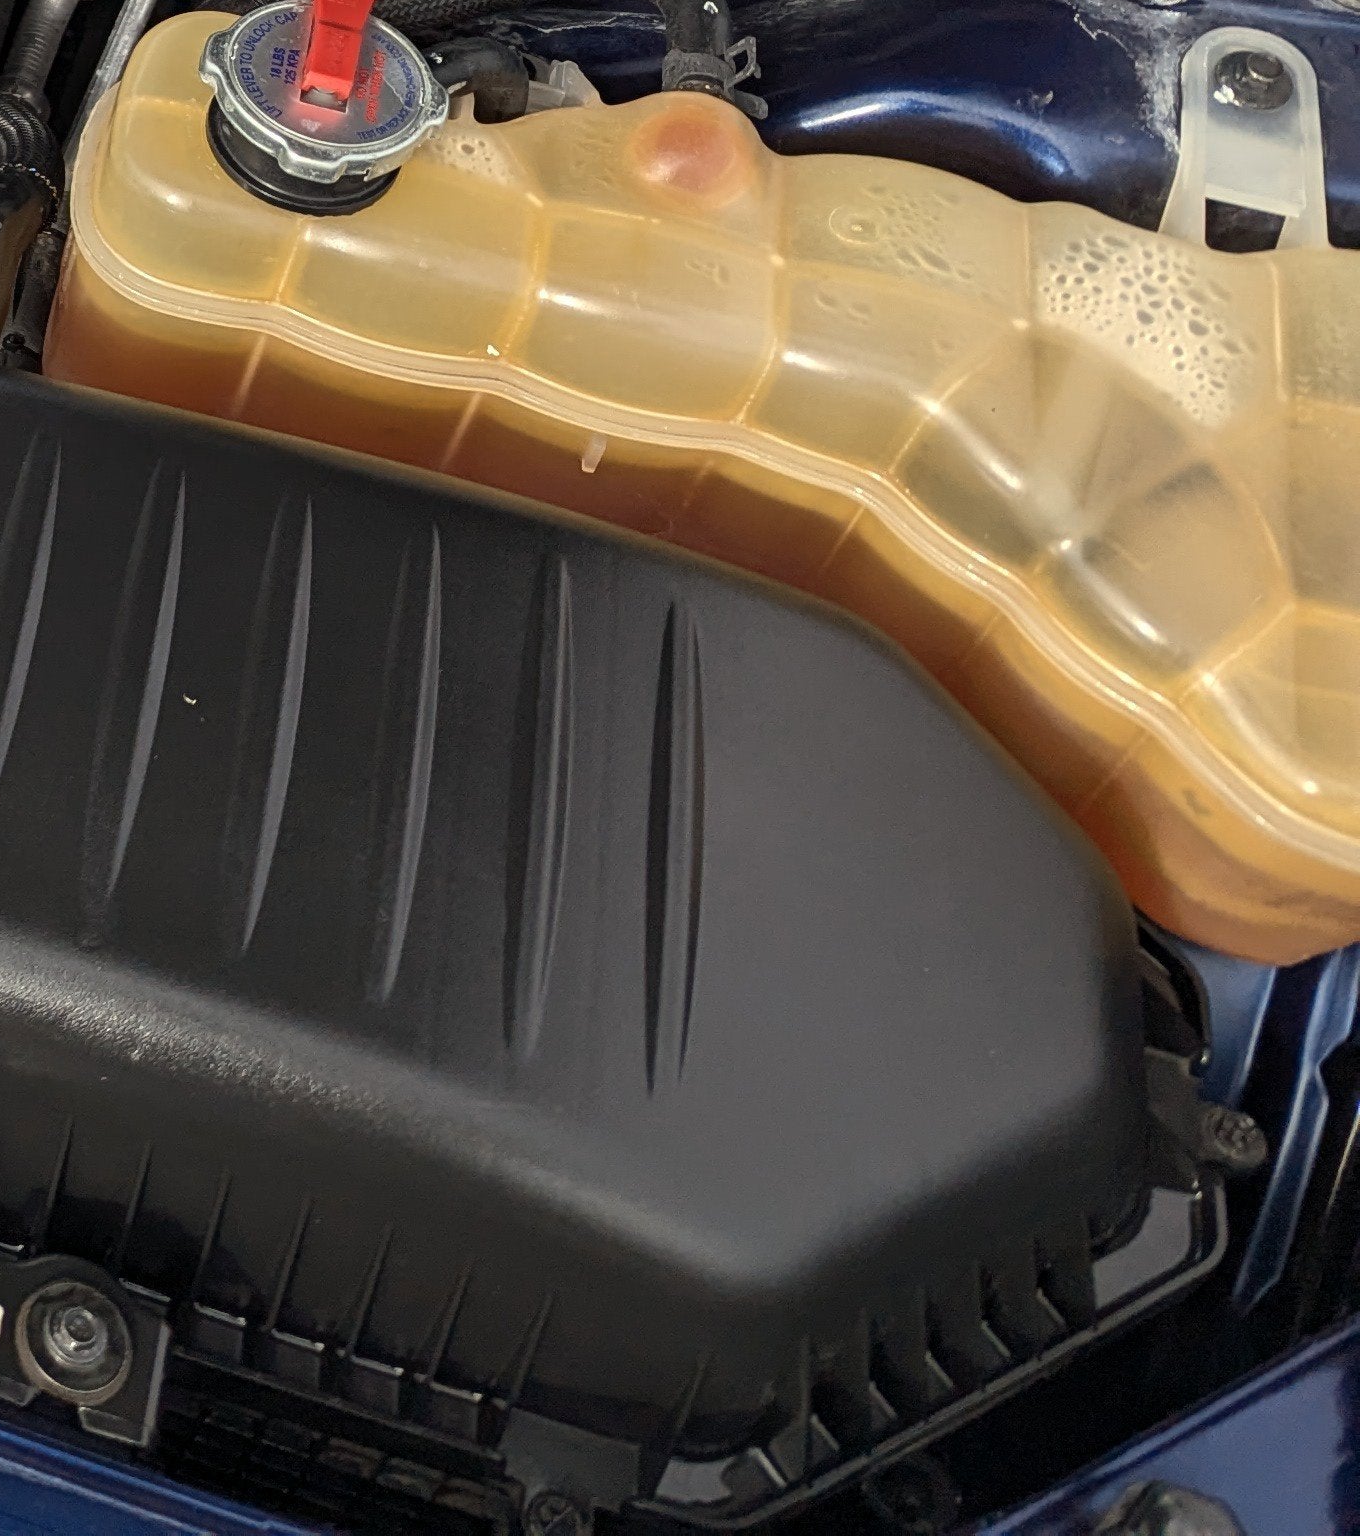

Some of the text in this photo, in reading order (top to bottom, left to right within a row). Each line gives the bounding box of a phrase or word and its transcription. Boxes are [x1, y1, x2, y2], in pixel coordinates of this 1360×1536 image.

[240, 11, 298, 119] LIFT LEVER TO UNLOCK CAP
[271, 47, 286, 67] LBS
[284, 49, 301, 85] 125 KPA
